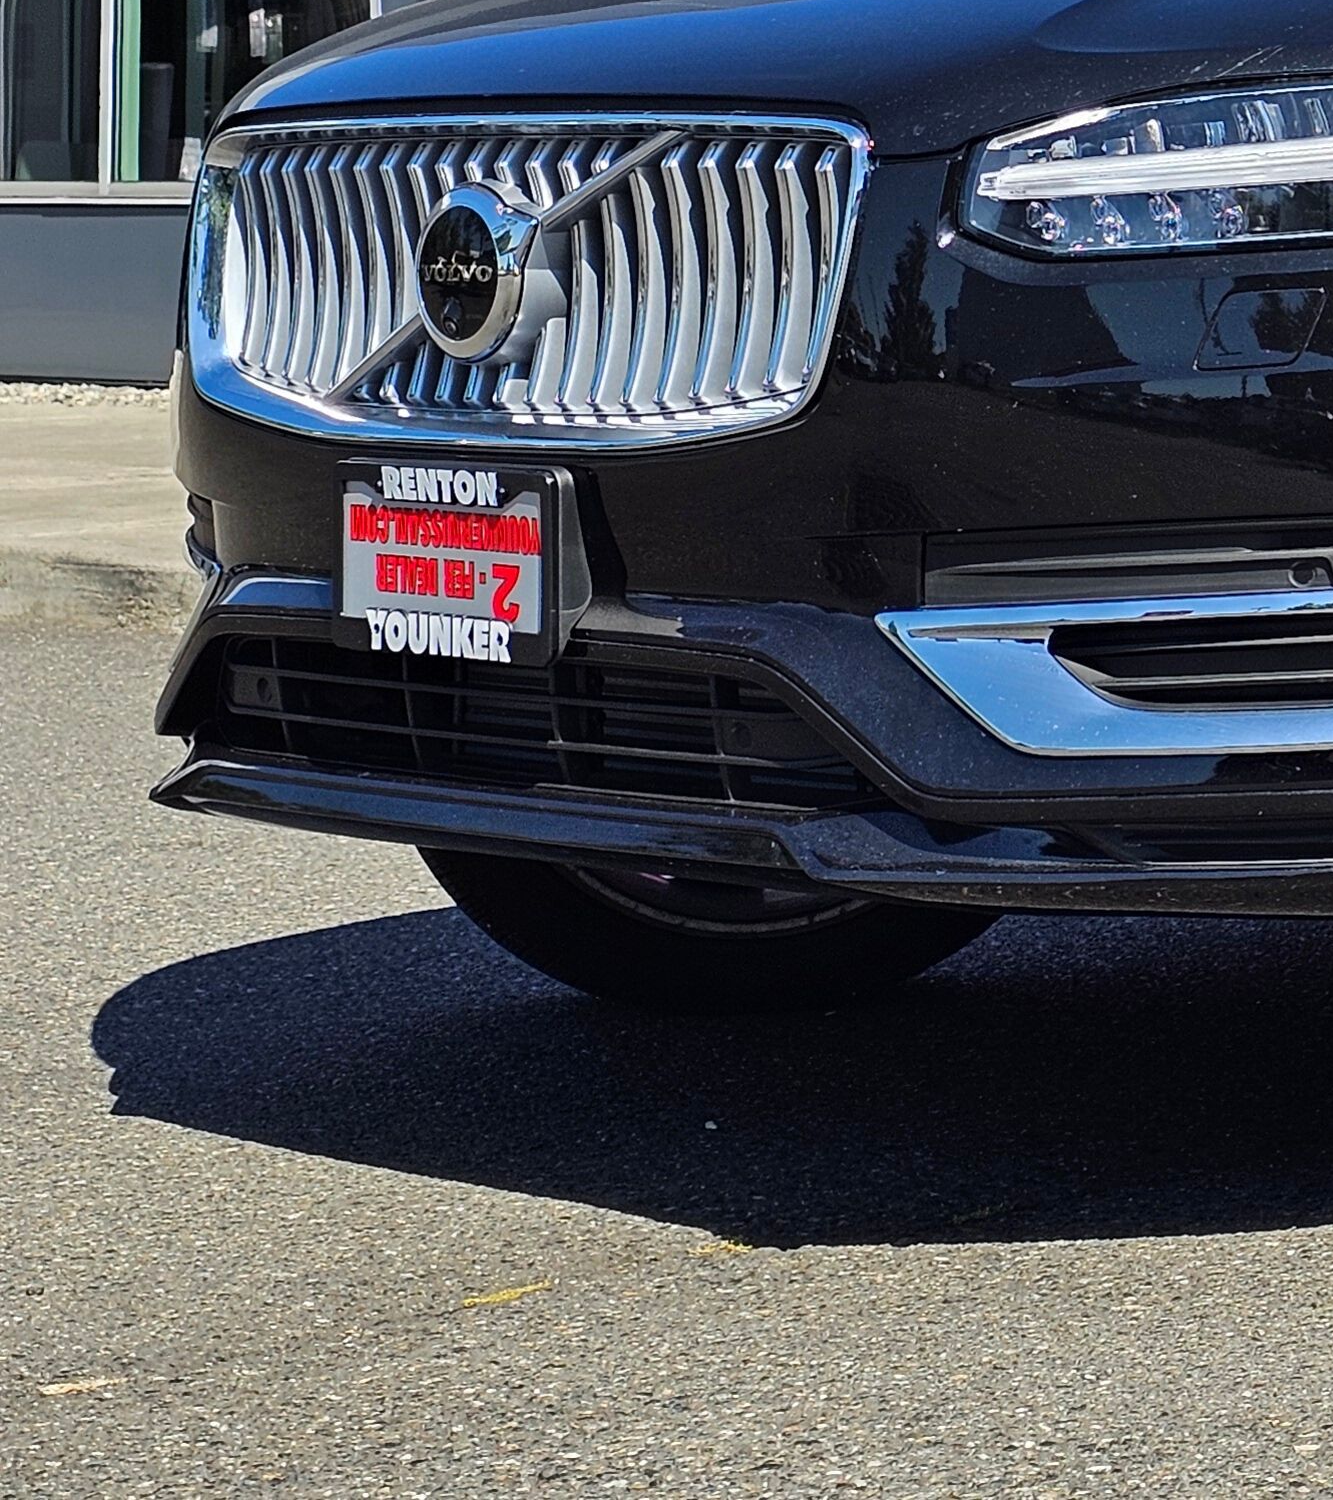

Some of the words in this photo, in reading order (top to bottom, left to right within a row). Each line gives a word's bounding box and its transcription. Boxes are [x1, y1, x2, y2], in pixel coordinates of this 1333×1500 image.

[423, 262, 494, 283] VOLVO
[380, 465, 500, 507] RENTON
[350, 503, 542, 557] YOUNKERNISSAN.COM
[375, 553, 438, 597] DEALER
[492, 563, 521, 624] 2
[365, 607, 512, 663] YOUNKER
